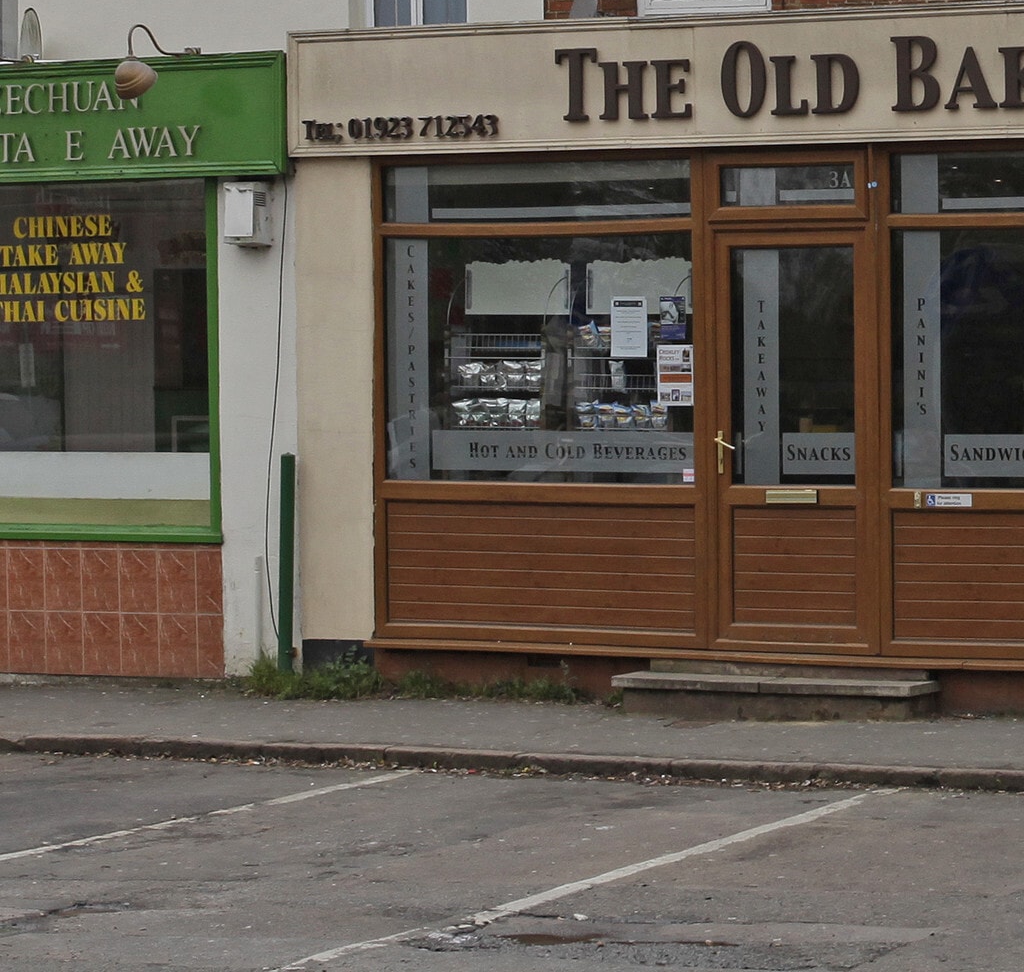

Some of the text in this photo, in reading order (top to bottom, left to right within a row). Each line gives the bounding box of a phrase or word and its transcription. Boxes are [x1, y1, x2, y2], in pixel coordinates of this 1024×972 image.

[555, 47, 693, 123] THE
[720, 39, 860, 118] OLD
[347, 116, 414, 140] 01923
[418, 114, 500, 139] 712543
[107, 124, 201, 160] AWAY
[829, 170, 852, 189] 3A
[13, 214, 113, 239] CHINESE
[0, 241, 127, 267] TAKE AWAY
[125, 269, 144, 294] &
[0, 298, 146, 323] HAI CUISINE
[756, 300, 768, 432] TAKEAWAY
[468, 441, 687, 461] HOT AND COLD BEVERAGES
[786, 443, 851, 463] SNACKS
